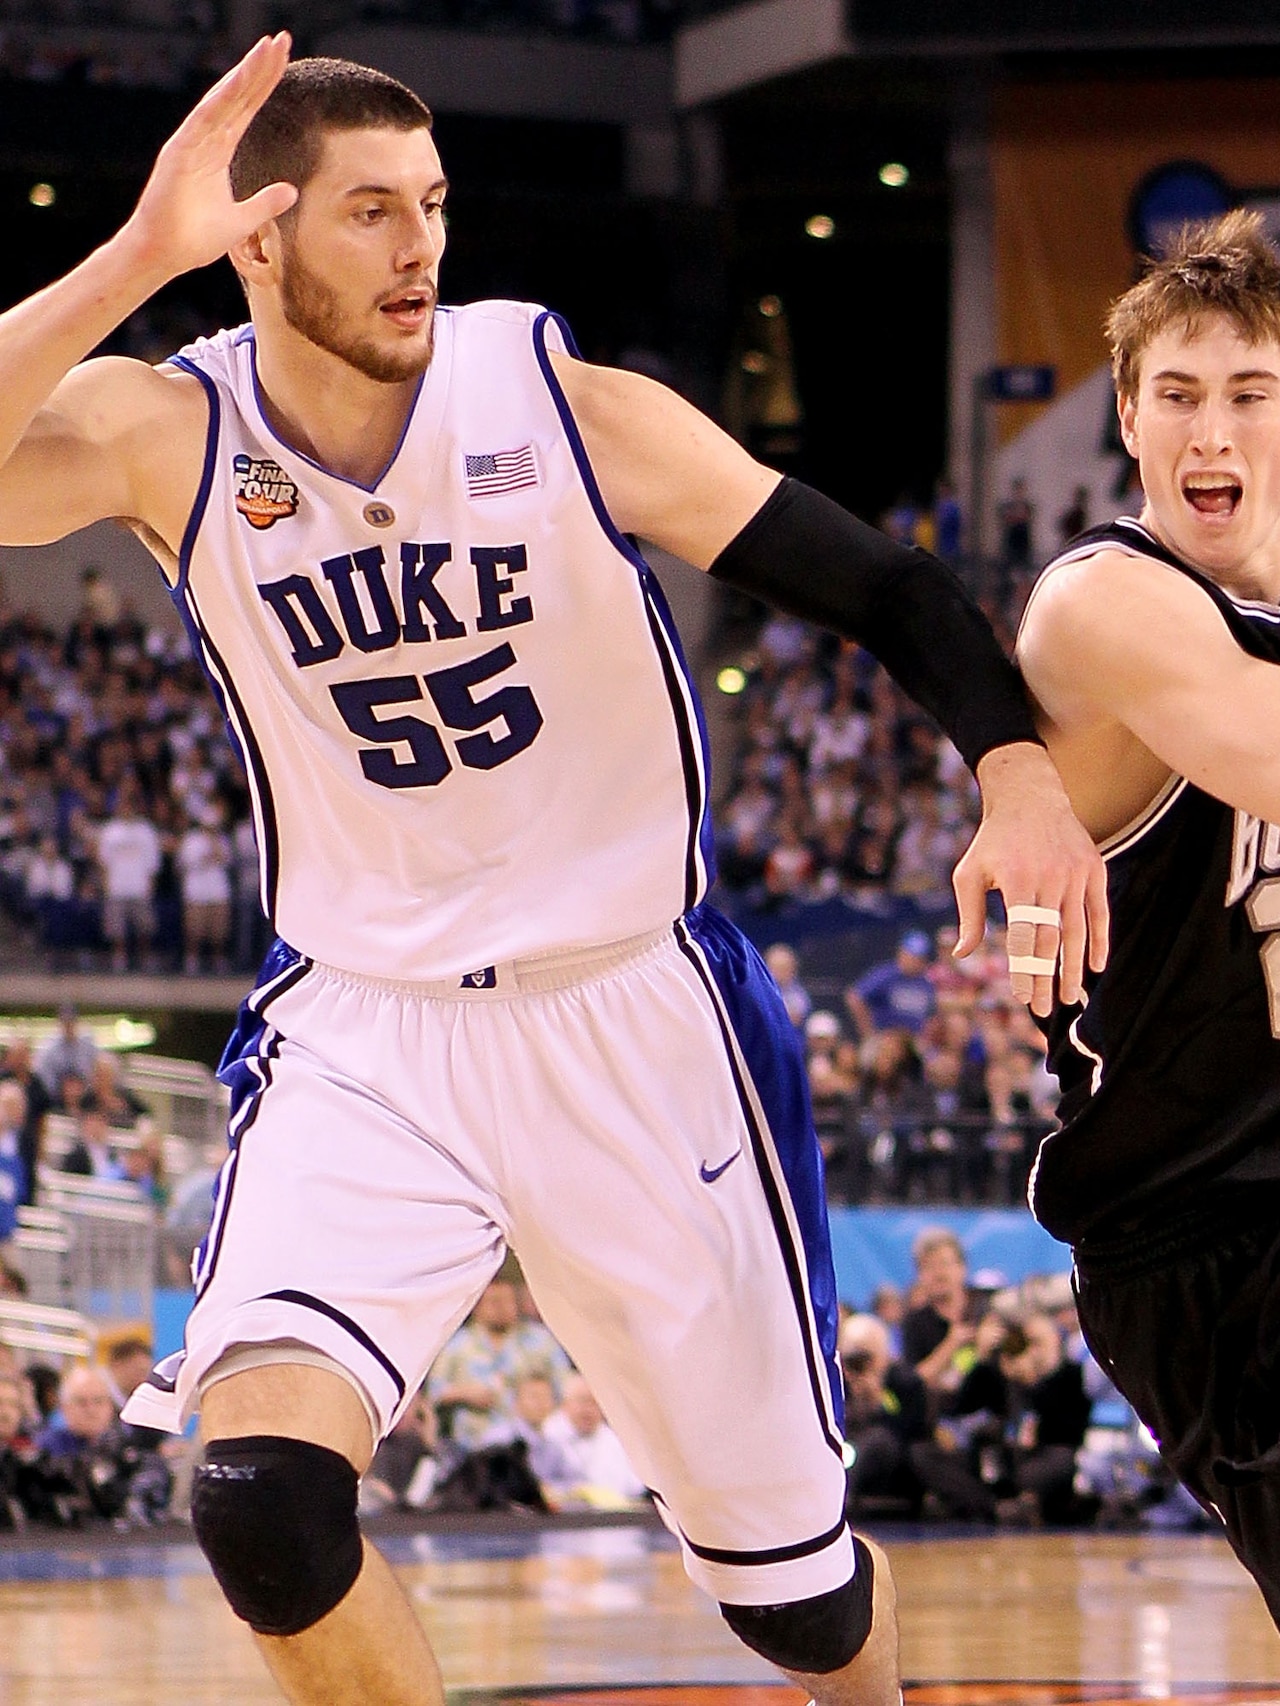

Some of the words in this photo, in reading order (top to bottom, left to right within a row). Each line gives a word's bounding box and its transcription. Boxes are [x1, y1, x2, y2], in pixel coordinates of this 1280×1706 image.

[234, 471, 296, 505] FOUR
[257, 542, 534, 668] DUKE
[328, 641, 544, 789] 55
